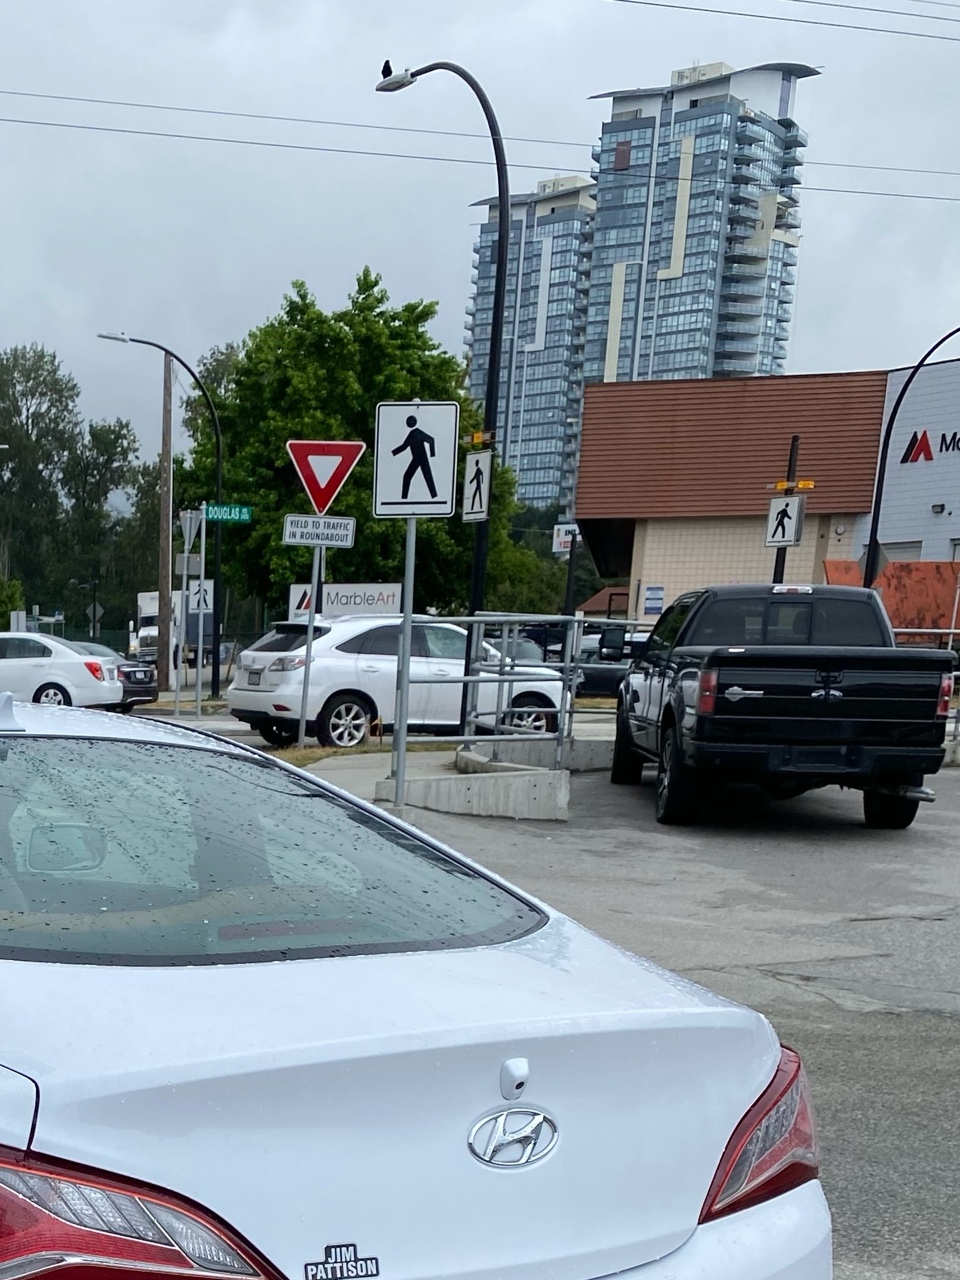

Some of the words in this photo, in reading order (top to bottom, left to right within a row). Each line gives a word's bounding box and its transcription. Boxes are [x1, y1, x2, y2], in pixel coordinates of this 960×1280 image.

[208, 506, 240, 520] DOUGLAS
[289, 519, 309, 529] YIELD
[312, 520, 321, 529] TO
[323, 521, 350, 531] TRAFFIC
[288, 530, 297, 539] IN
[300, 531, 349, 543] ROUNDABOUT
[326, 591, 396, 606] MarbleArt
[327, 1247, 355, 1263] JIM
[307, 1260, 377, 1280] PATTISON
